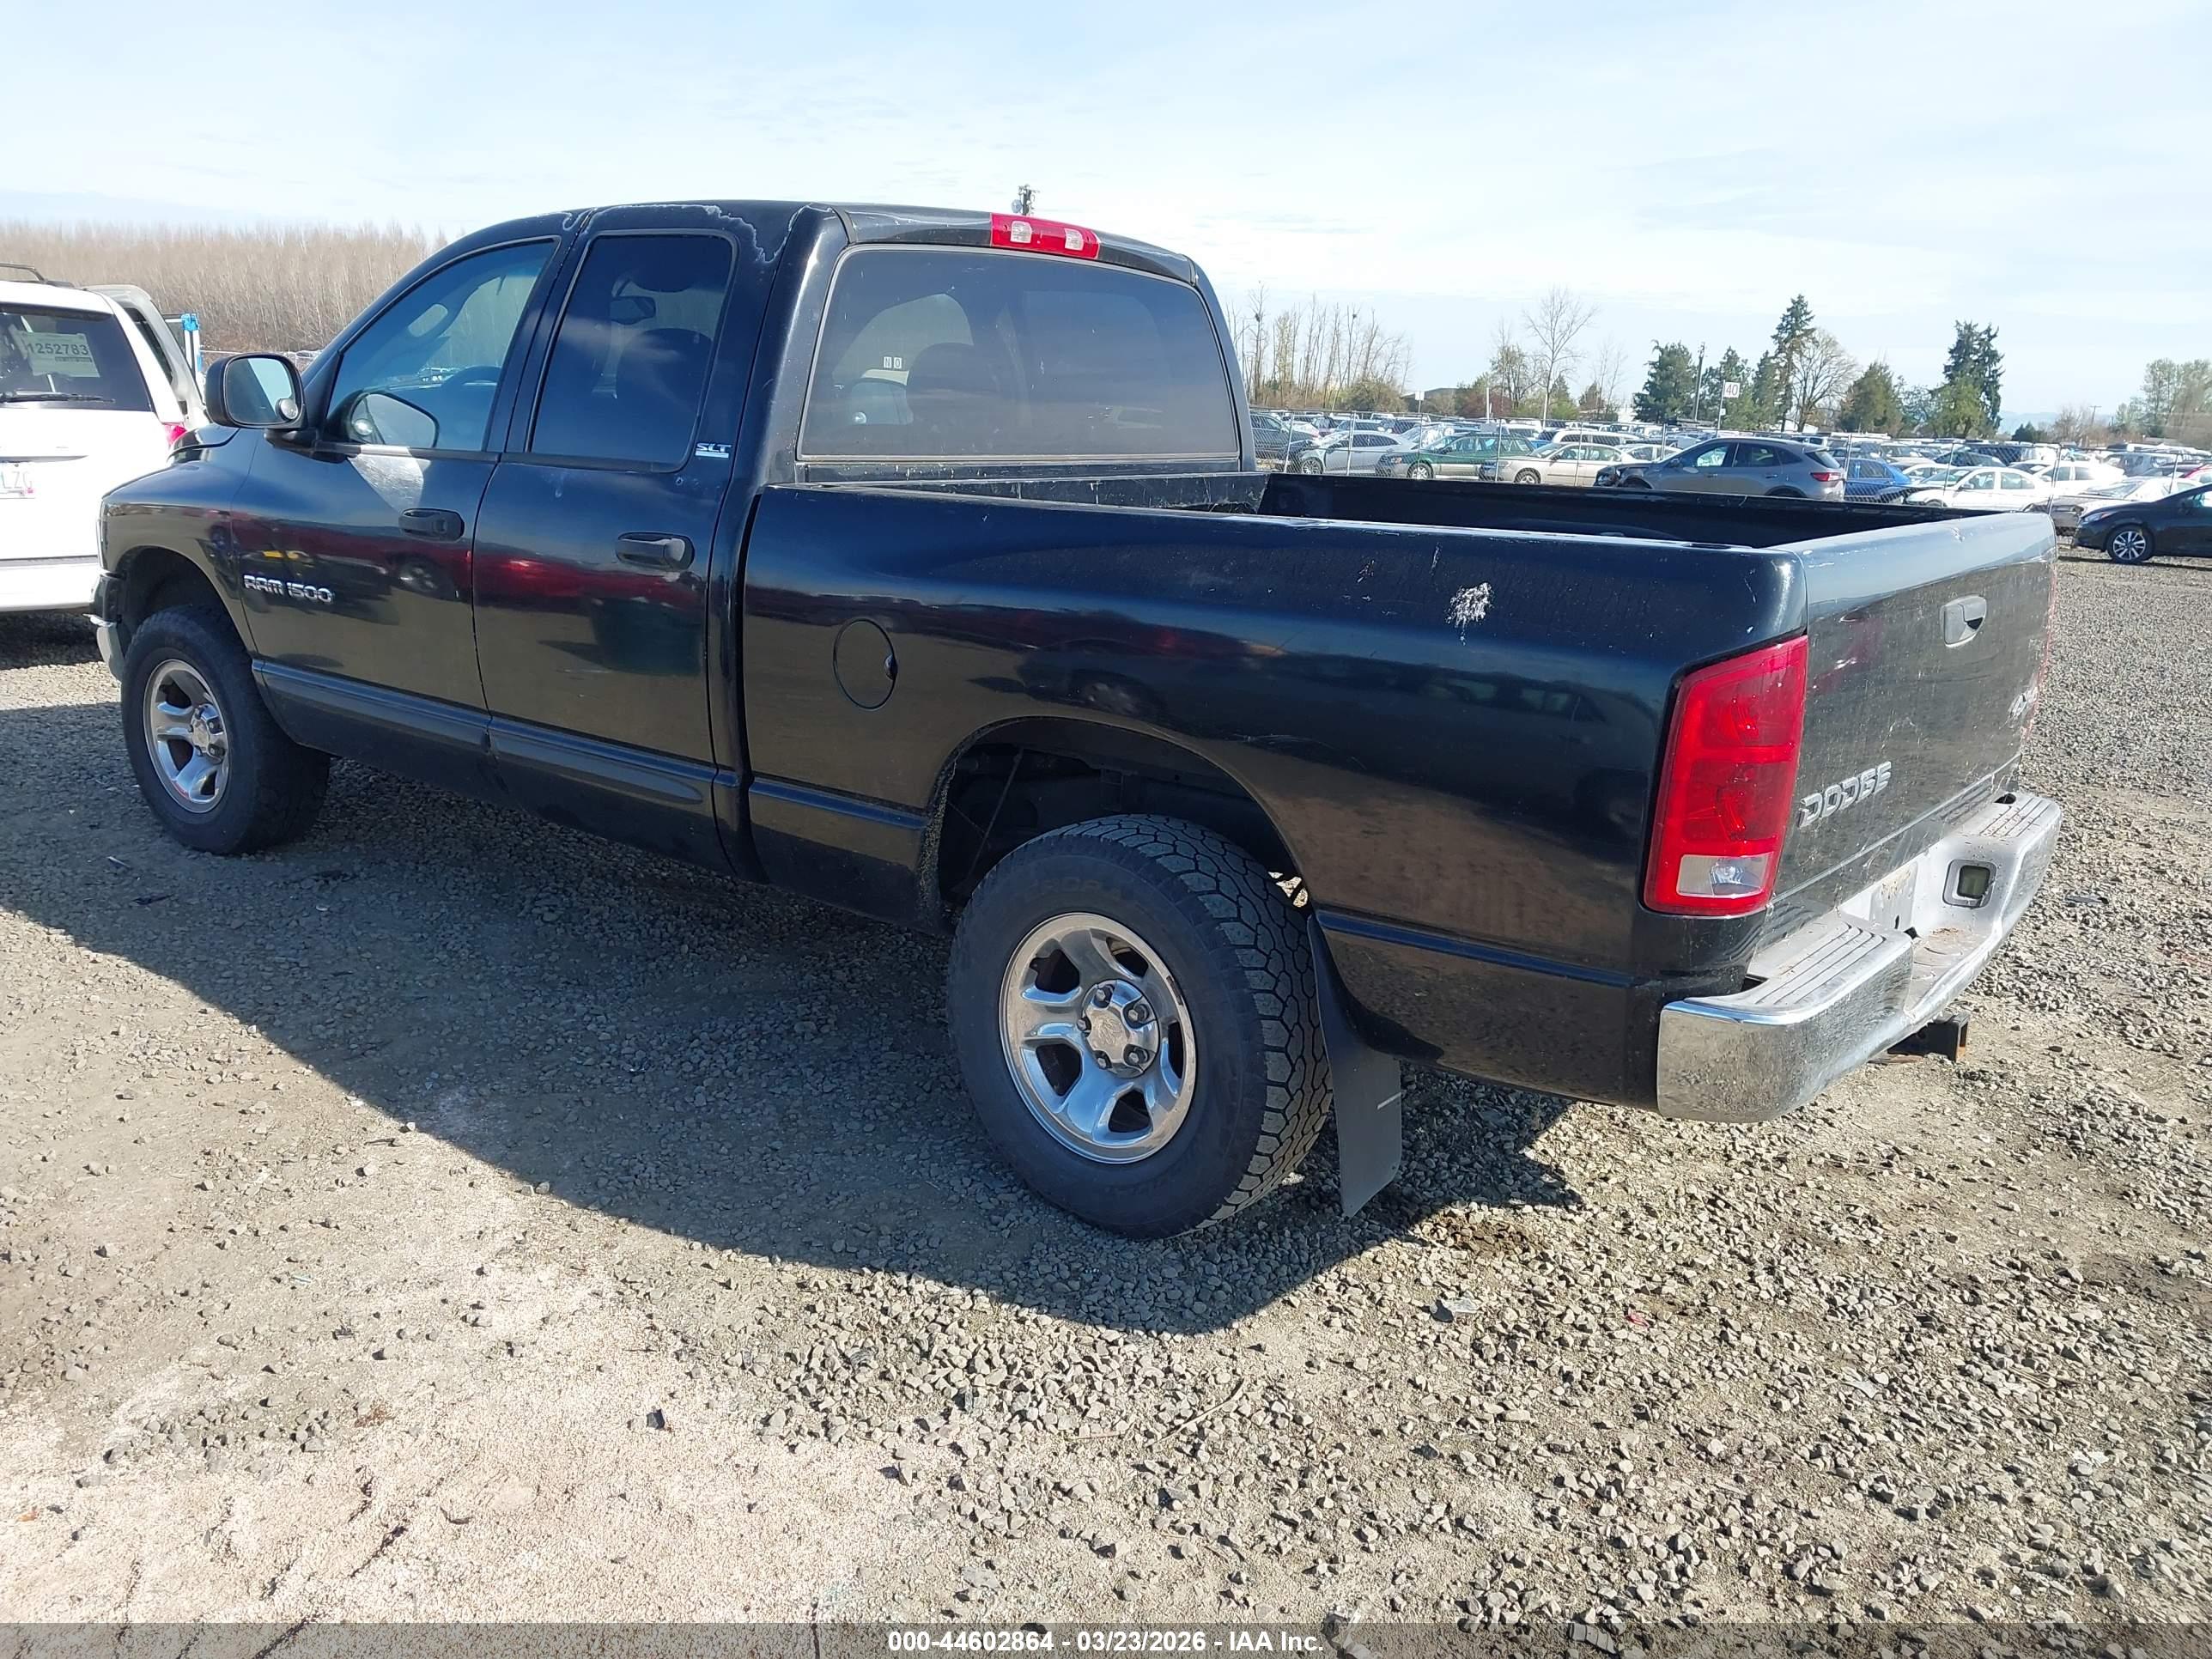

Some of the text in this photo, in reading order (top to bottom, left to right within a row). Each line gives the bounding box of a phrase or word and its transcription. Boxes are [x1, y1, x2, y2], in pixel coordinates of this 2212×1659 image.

[27, 343, 89, 356] 1252783
[1725, 384, 1739, 396] 40
[696, 442, 732, 453] SLT
[243, 574, 332, 604] RAM 1500
[1796, 761, 1892, 830] DODGE
